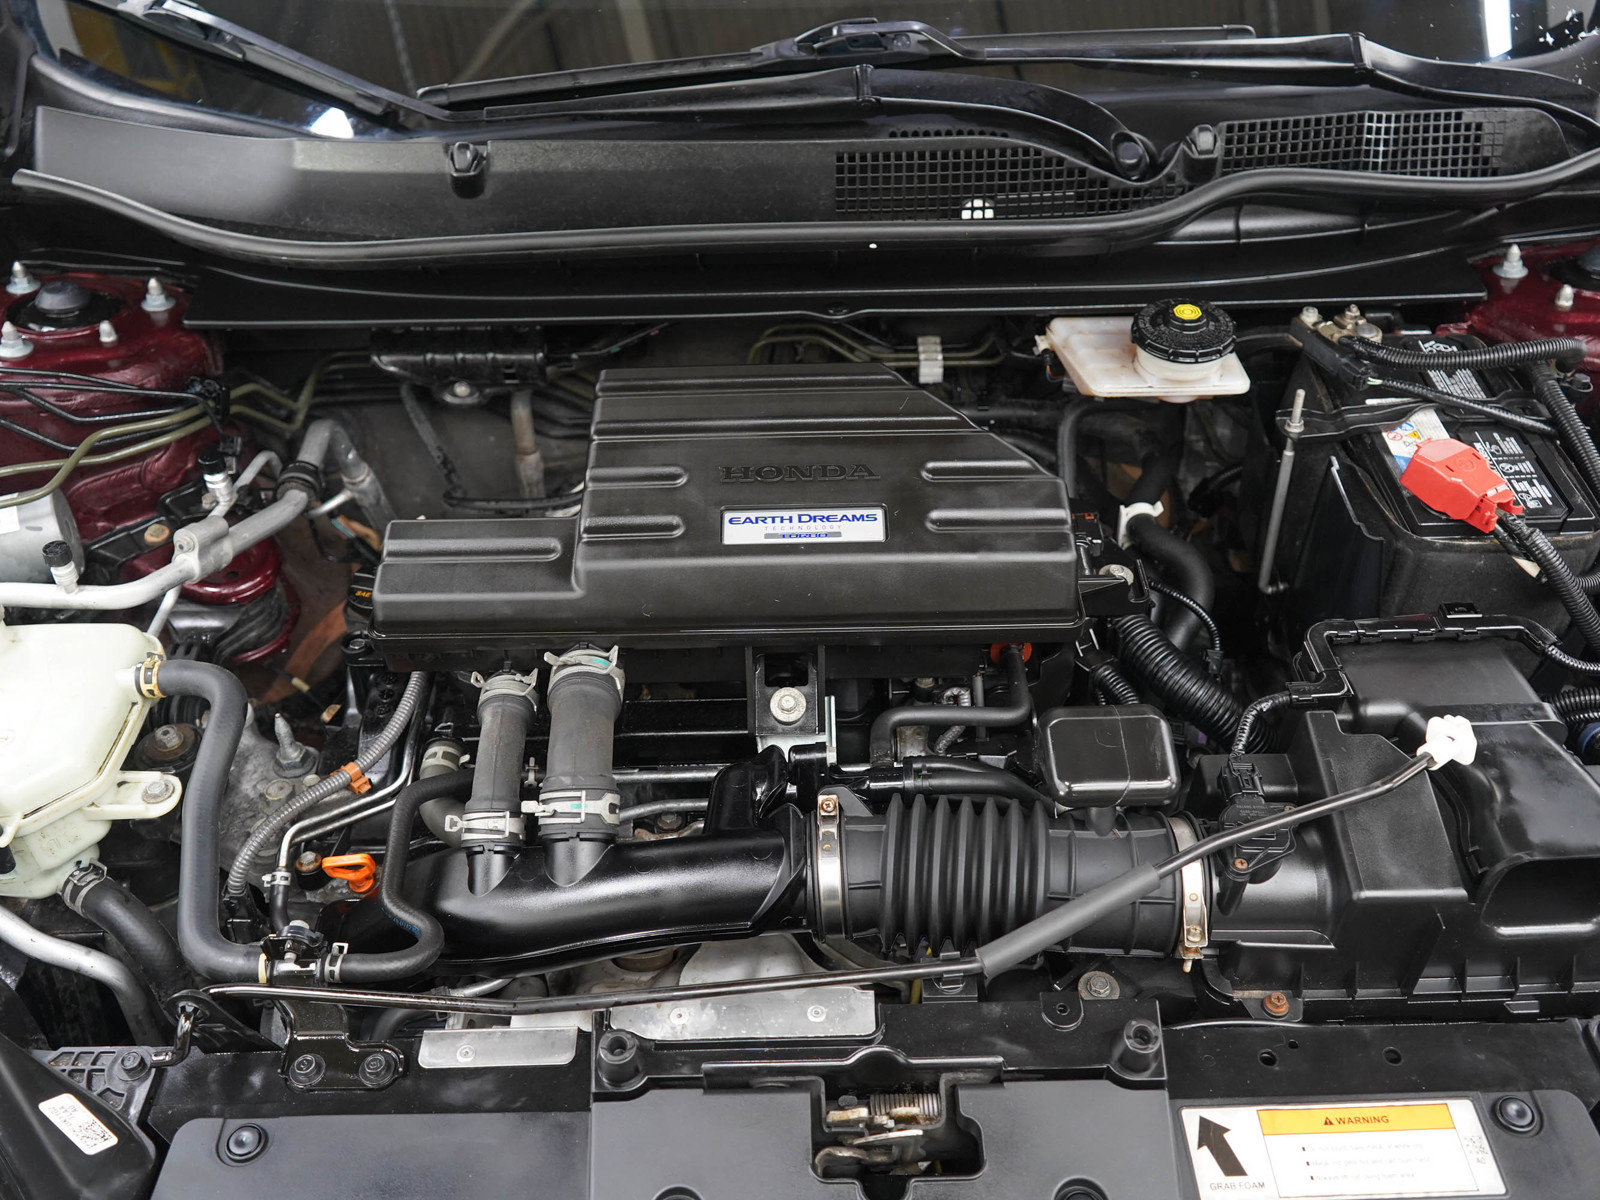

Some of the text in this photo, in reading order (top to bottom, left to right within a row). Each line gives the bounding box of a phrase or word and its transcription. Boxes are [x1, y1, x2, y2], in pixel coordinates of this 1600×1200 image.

[719, 464, 881, 483] HONDA
[728, 513, 878, 525] EARTH DREAMS
[1335, 1115, 1390, 1125] WARNING
[1209, 1181, 1266, 1191] GRAB FOAM
